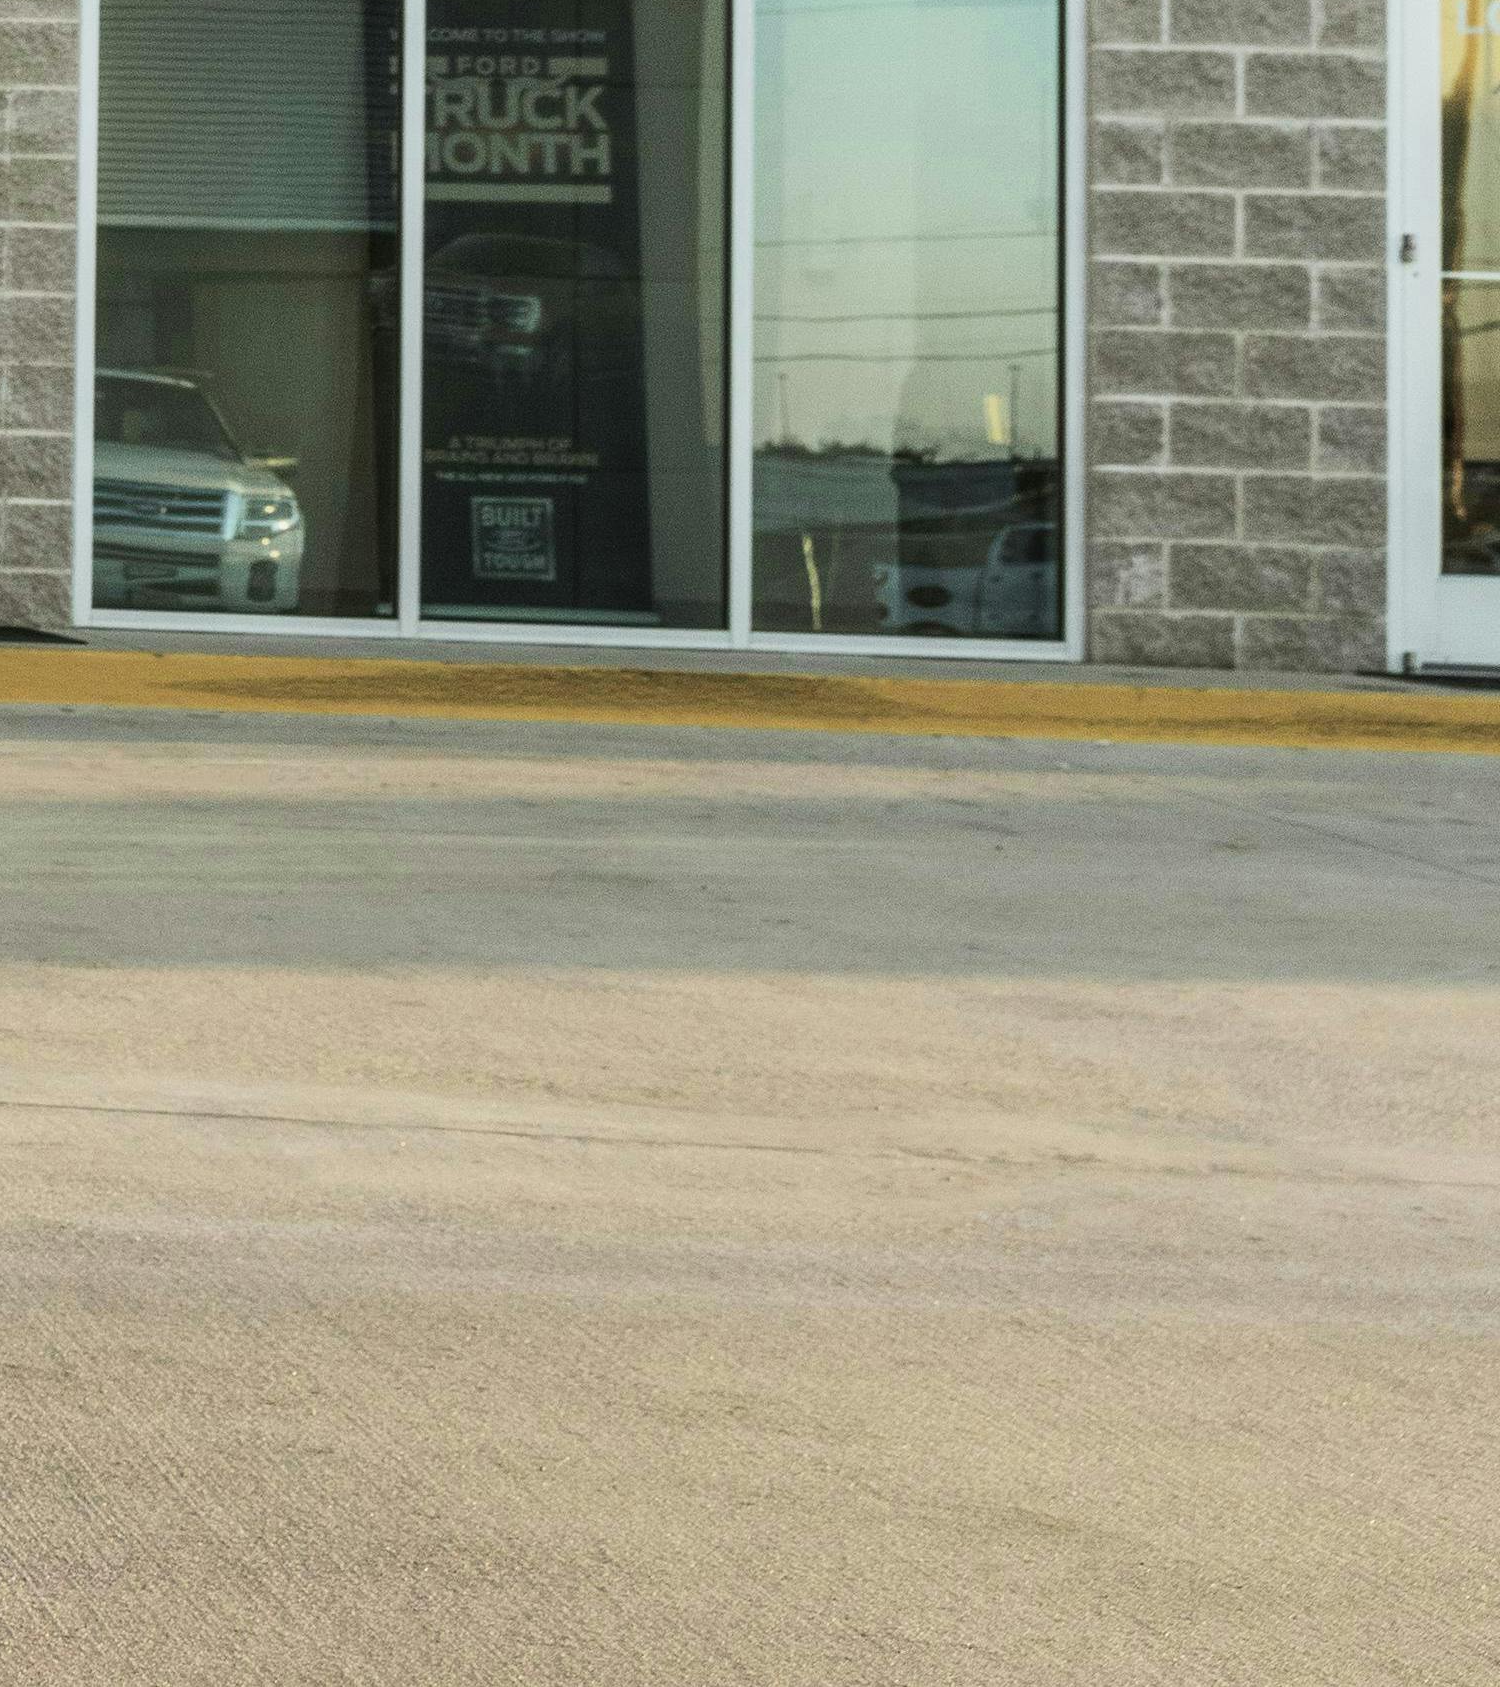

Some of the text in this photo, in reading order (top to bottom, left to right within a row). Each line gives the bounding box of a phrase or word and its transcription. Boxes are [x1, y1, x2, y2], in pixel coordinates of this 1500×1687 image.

[483, 28, 508, 43] TO
[512, 28, 548, 44] THE
[455, 54, 542, 76] FORD
[388, 79, 609, 130] RUCK
